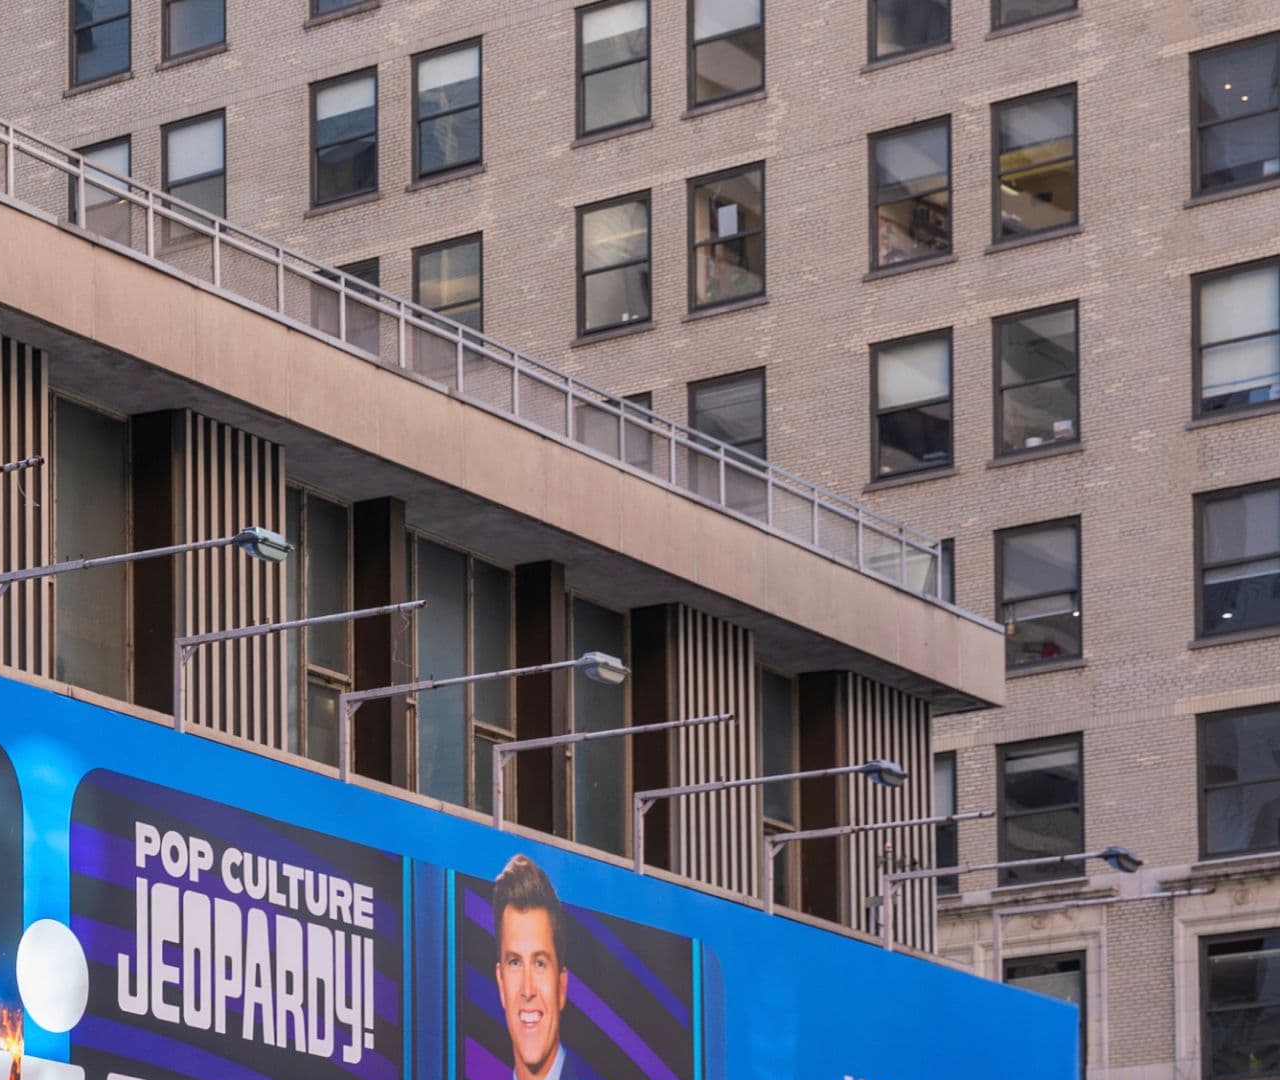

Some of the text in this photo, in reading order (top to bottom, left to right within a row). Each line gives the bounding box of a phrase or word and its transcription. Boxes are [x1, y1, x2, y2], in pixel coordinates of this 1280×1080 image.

[135, 821, 374, 930] POP CULTURE
[117, 876, 375, 1064] JEOPARDY!
